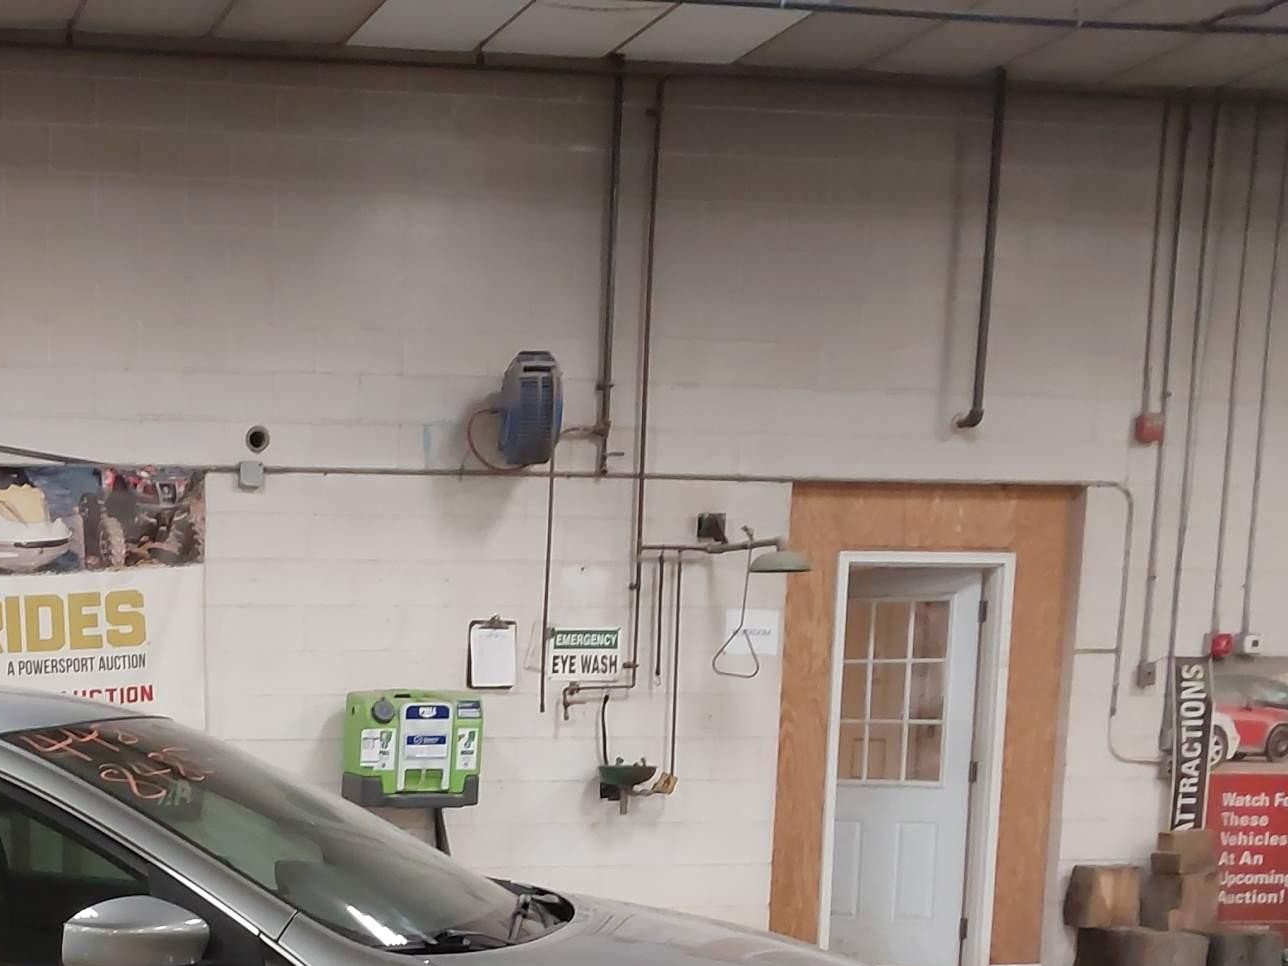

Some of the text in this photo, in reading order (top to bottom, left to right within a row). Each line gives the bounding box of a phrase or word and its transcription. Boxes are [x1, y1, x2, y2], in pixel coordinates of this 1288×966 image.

[556, 633, 617, 647] EMERGENCY
[7, 653, 146, 676] A POWERSPORT AUCTION
[552, 654, 617, 674] EYE WASH
[1222, 792, 1270, 807] Watch
[1221, 811, 1269, 826] These
[1220, 831, 1288, 846] Vehicles
[1218, 851, 1264, 865] At An
[1218, 889, 1285, 904] Auction!
